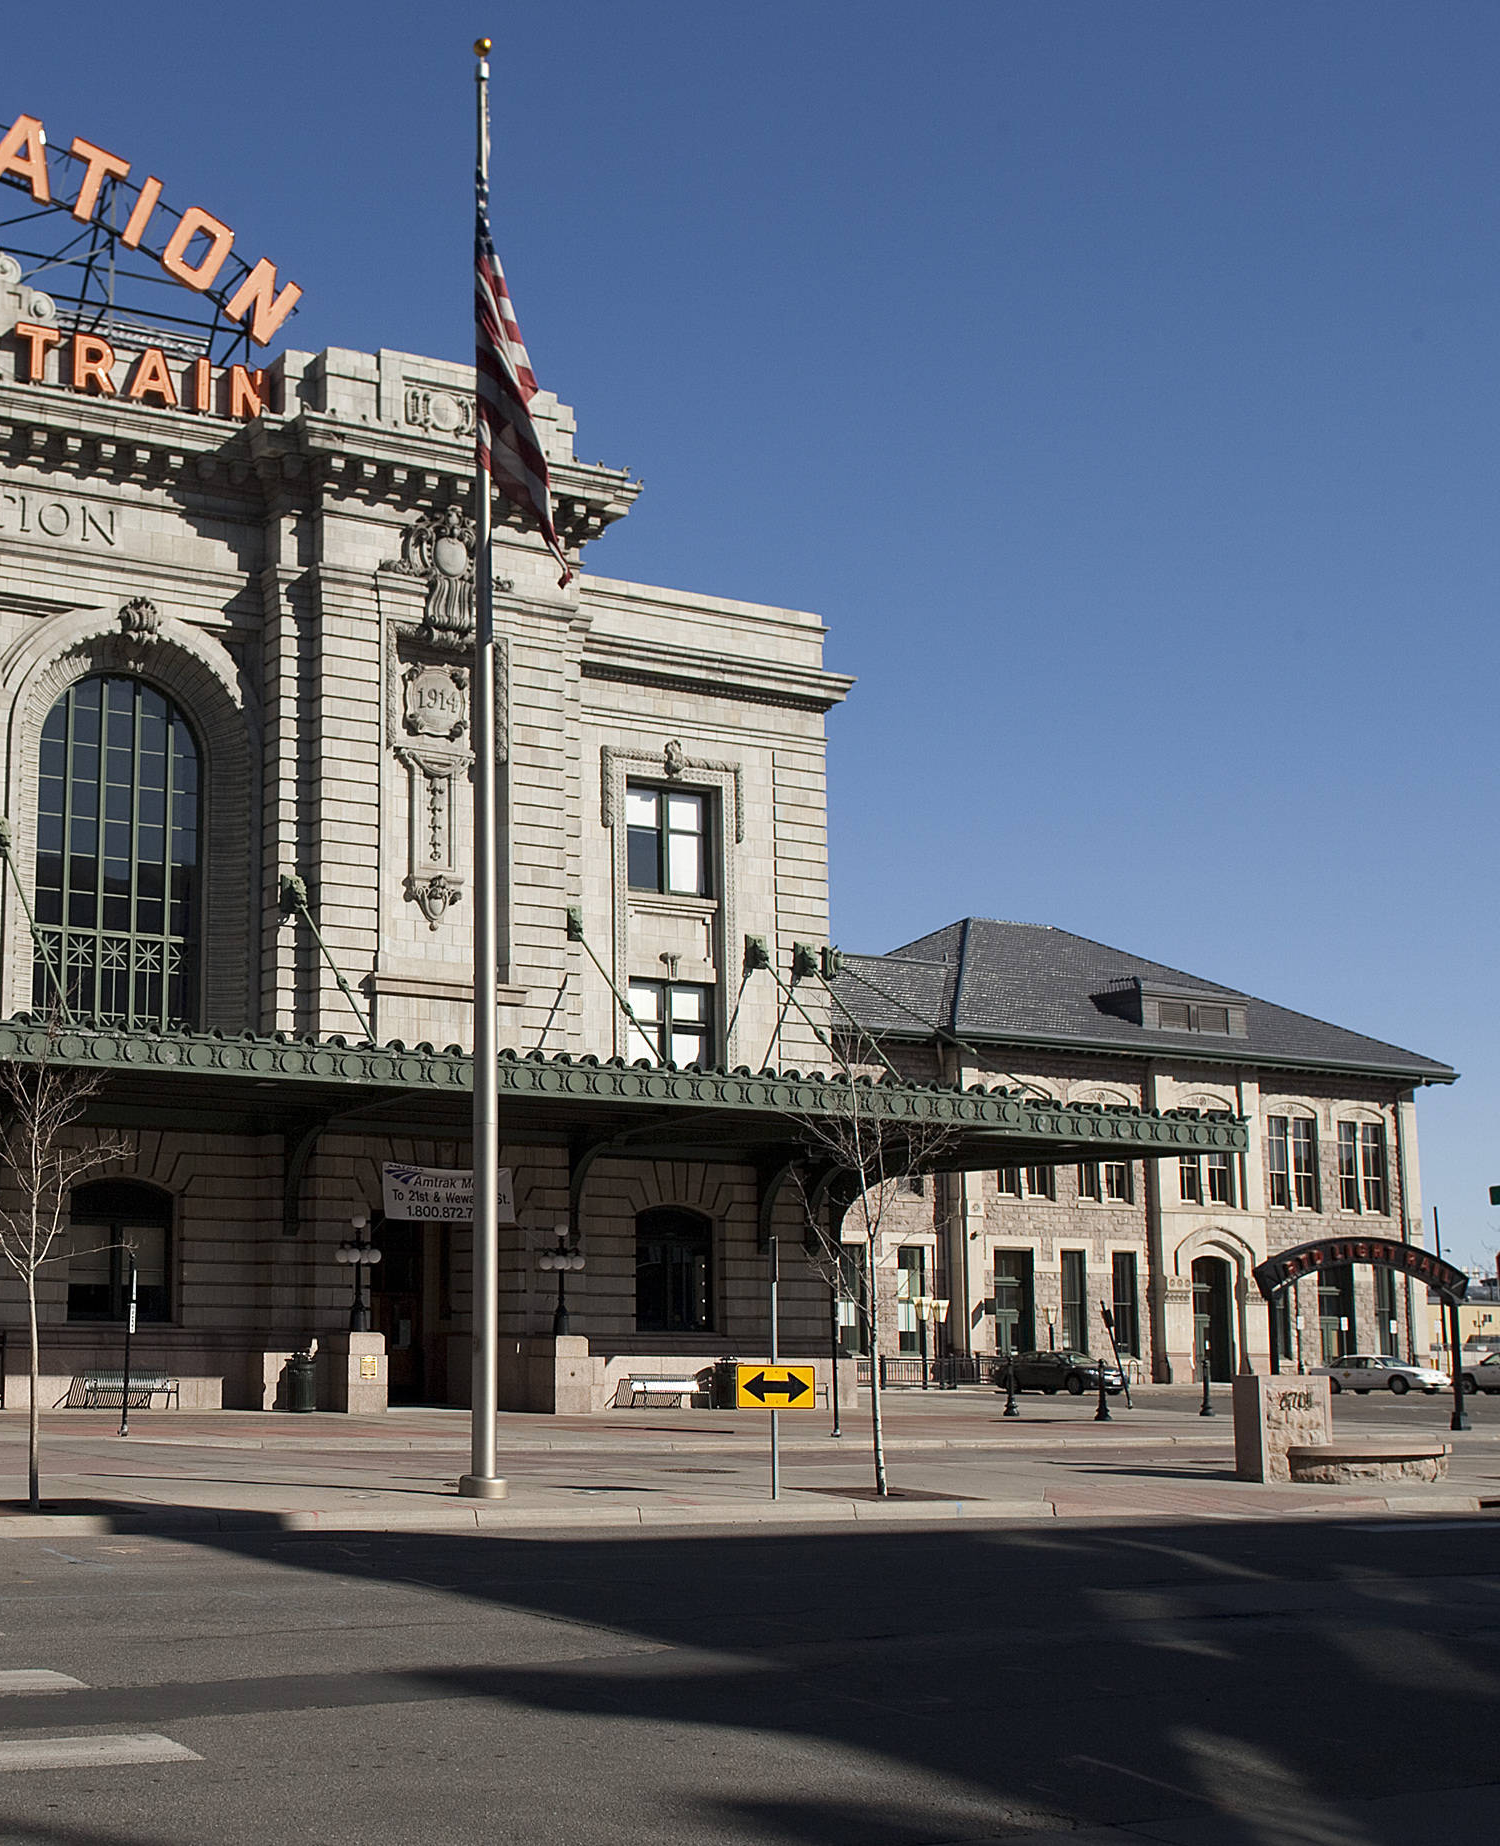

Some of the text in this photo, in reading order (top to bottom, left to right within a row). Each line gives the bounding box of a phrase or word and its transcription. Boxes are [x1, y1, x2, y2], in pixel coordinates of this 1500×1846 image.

[16, 322, 267, 418] TRAIN
[417, 688, 456, 713] 1914
[413, 1175, 458, 1189] Amtrak
[392, 1189, 404, 1201] To
[408, 1189, 429, 1202] 21st
[433, 1192, 441, 1202] &
[1331, 1242, 1396, 1260] LIGHT
[1404, 1251, 1451, 1283] RAIL
